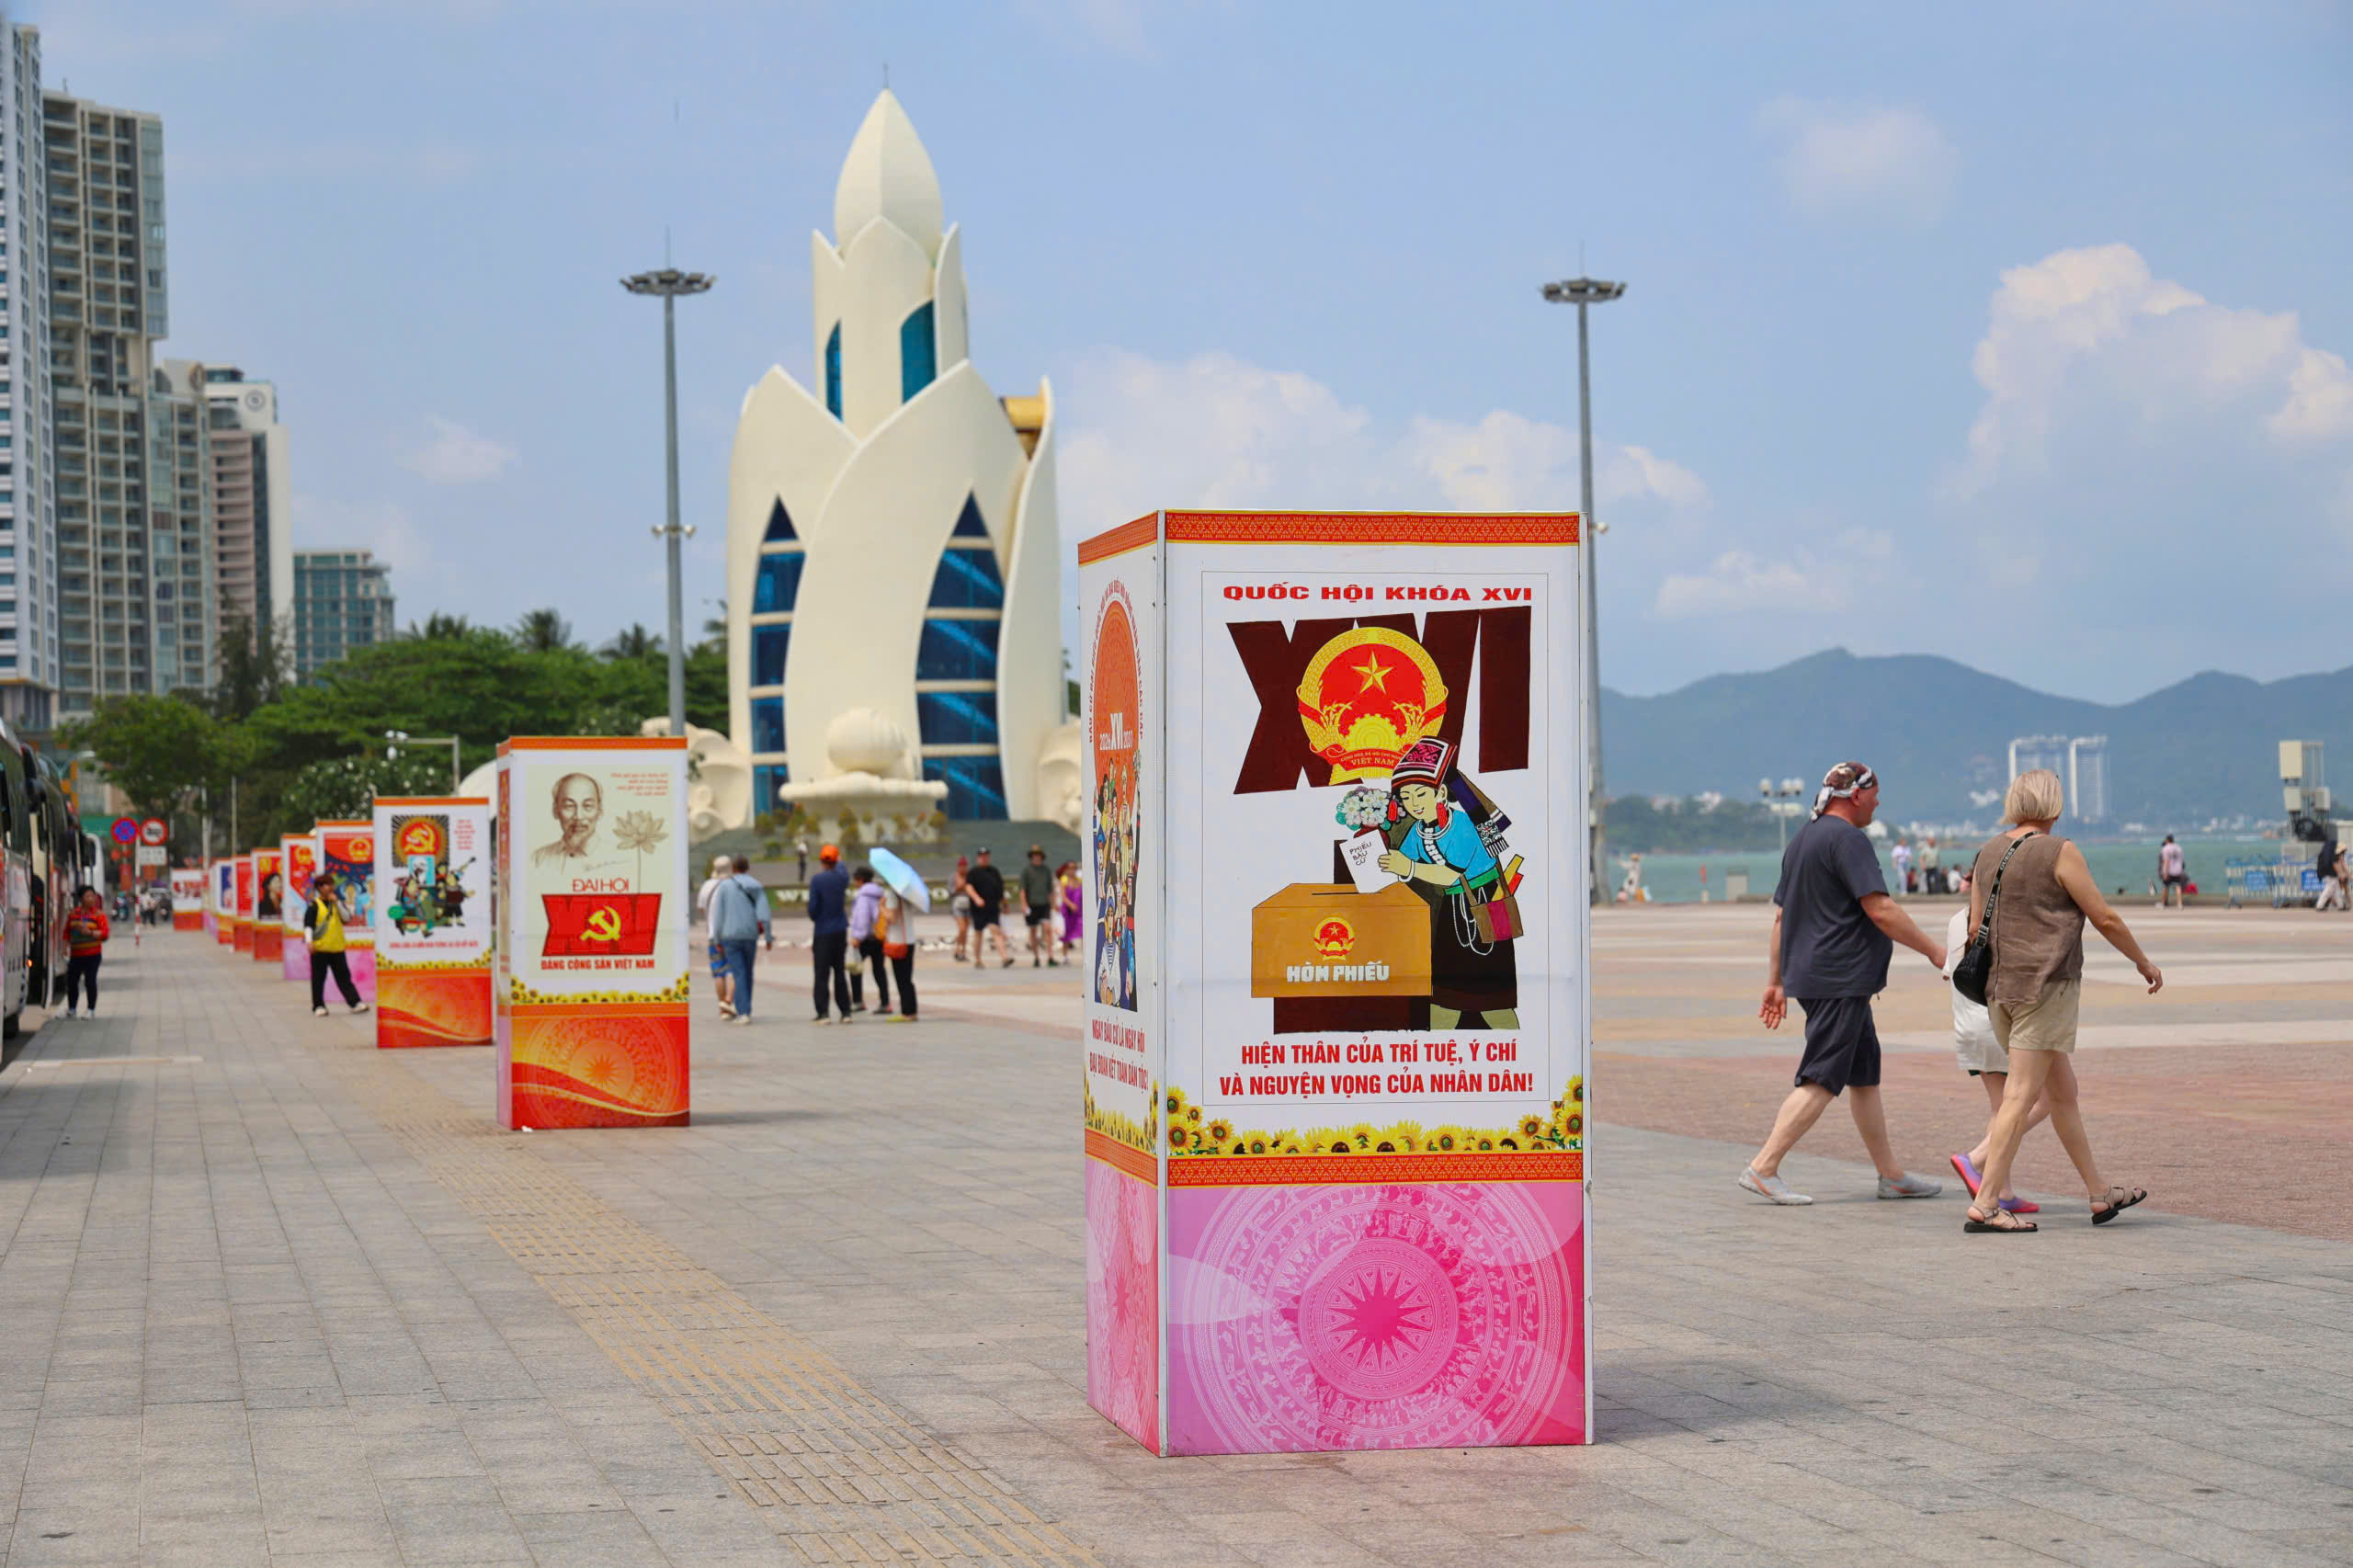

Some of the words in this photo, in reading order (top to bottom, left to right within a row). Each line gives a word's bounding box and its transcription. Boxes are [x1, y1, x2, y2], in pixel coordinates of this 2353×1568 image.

[1223, 581, 1310, 601] QUỐC
[1321, 585, 1374, 603] HỘI
[1385, 585, 1471, 601] KHÓA
[1482, 587, 1532, 601] XVI
[1374, 757, 1394, 767] NAM
[1999, 847, 2016, 870] GUESS
[1984, 893, 1996, 918] GUESS
[635, 959, 655, 969] NAM
[1286, 960, 1329, 982] HÒM
[1333, 960, 1390, 982] PHIẾU
[1242, 1041, 1285, 1068] HIỆN
[1291, 1040, 1340, 1063] THÂN
[1347, 1036, 1384, 1063] CỦA
[1390, 1039, 1418, 1062] TRÍ
[1424, 1039, 1463, 1065] TUỆ,
[1470, 1039, 1481, 1062] Ý
[1485, 1038, 1517, 1062] CHÍ
[1220, 1072, 1244, 1096] VÀ
[1250, 1072, 1324, 1099] NGUYỆN
[1330, 1074, 1381, 1098] VỌNG
[1387, 1066, 1425, 1094] CỦA
[1430, 1070, 1483, 1093] NHÂN
[1488, 1069, 1533, 1093] DÂN!
